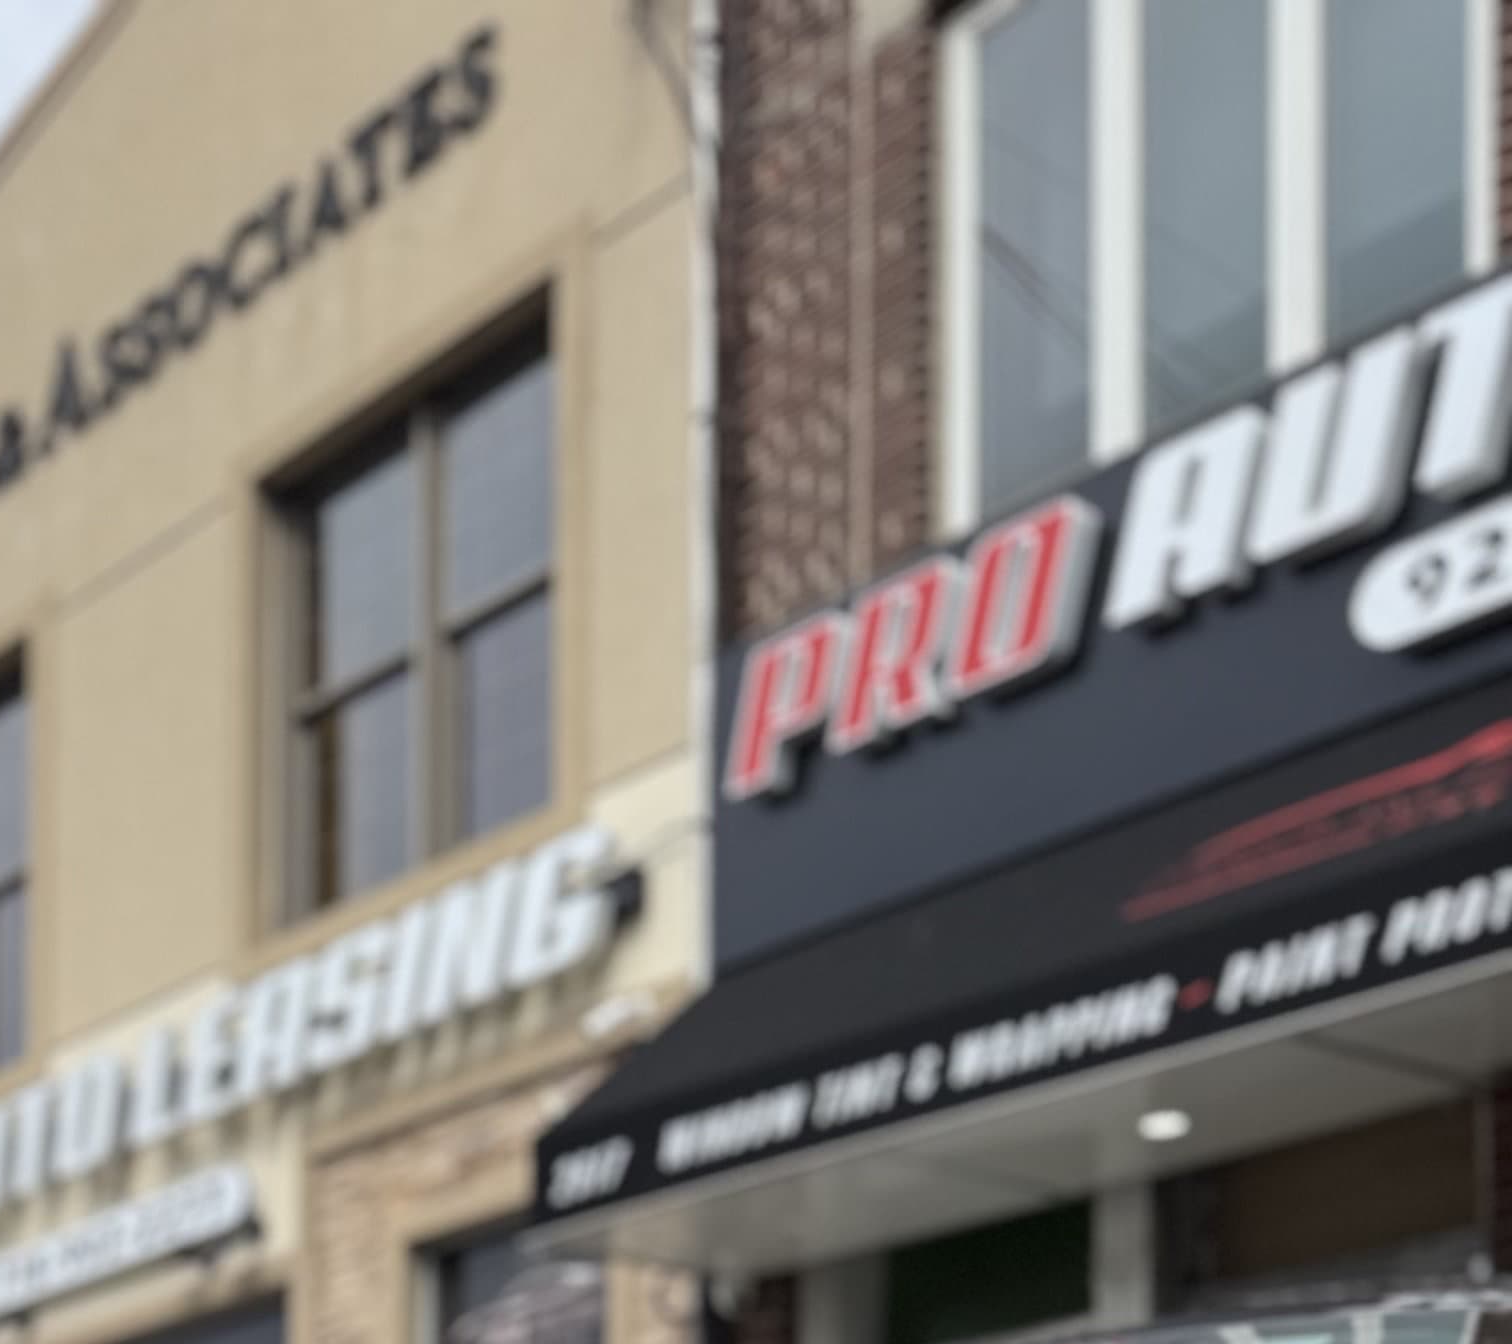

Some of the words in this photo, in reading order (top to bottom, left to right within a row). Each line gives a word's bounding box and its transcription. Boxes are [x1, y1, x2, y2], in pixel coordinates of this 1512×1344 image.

[40, 22, 500, 456] ASSOCIATES
[726, 496, 1100, 797] PRO
[1102, 274, 1512, 630] AUT
[130, 824, 618, 1150] LEASING
[810, 1051, 905, 1130] TINT
[945, 971, 1178, 1092] WRAPPING
[1215, 910, 1377, 1016] PAINT
